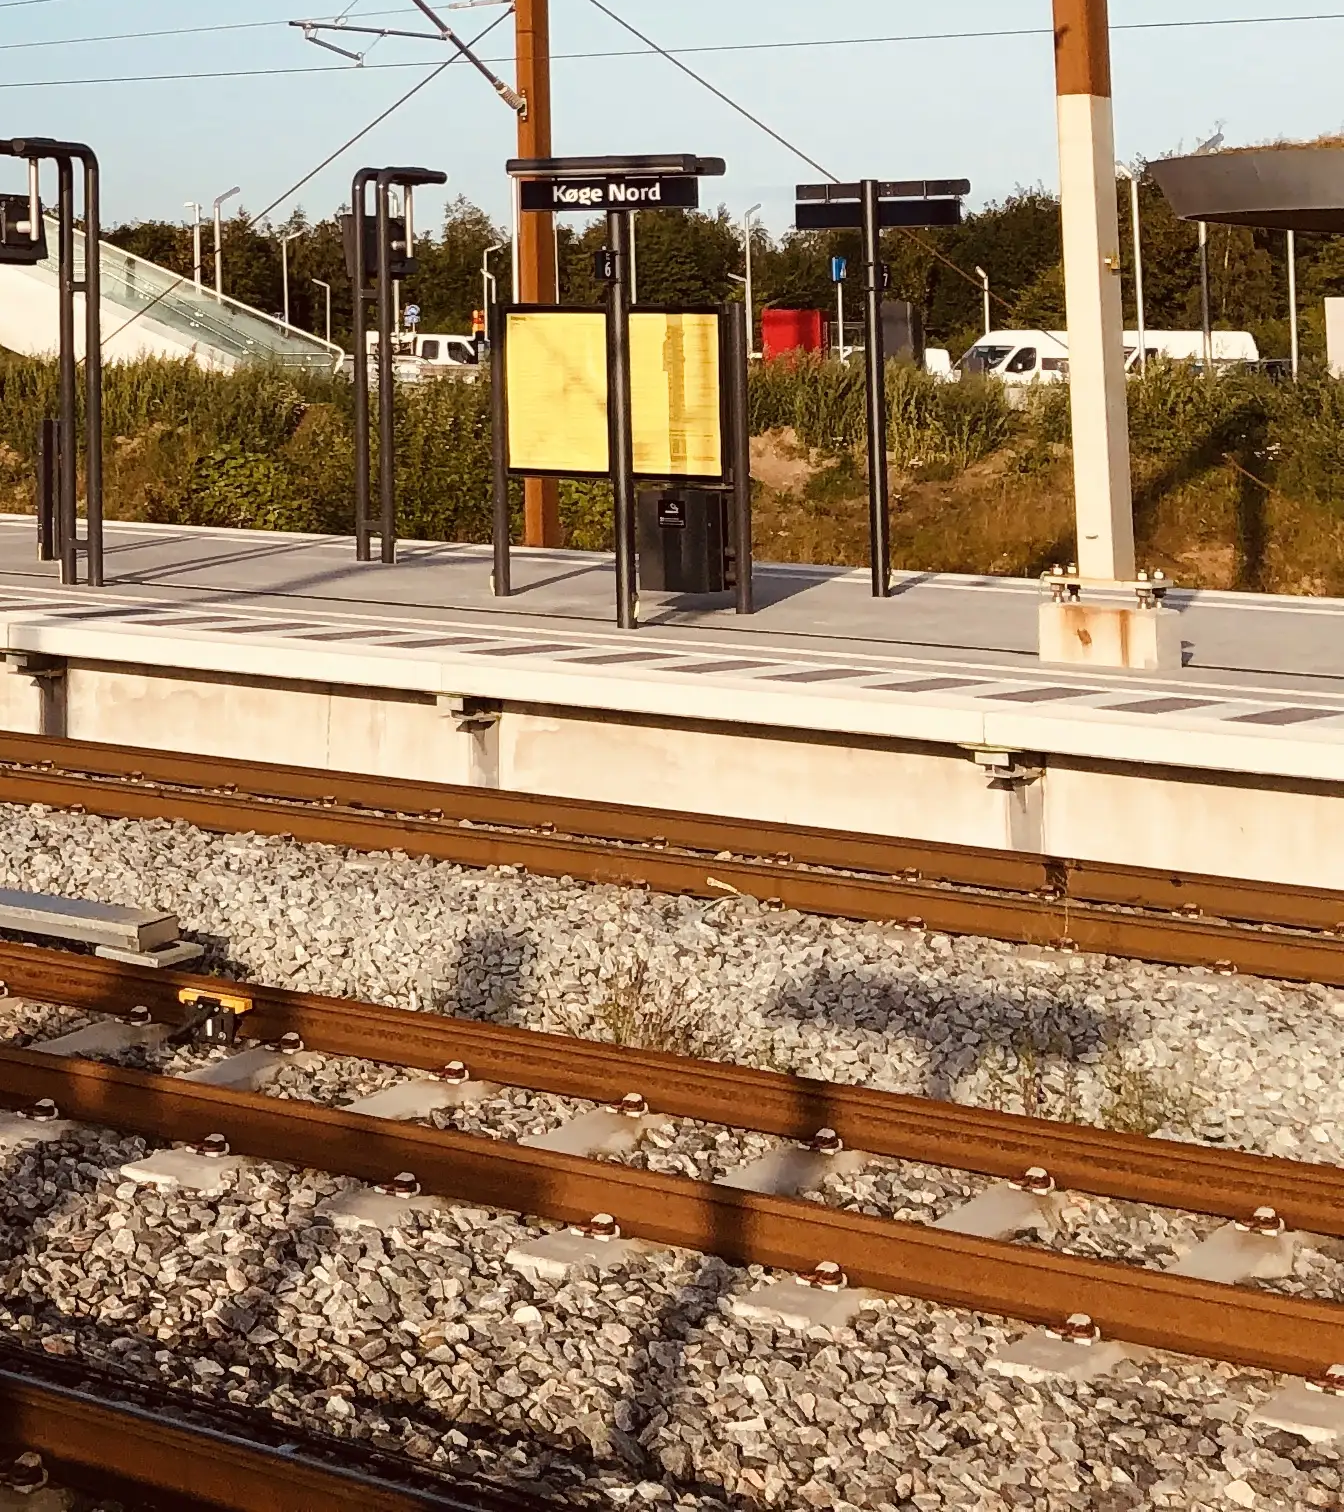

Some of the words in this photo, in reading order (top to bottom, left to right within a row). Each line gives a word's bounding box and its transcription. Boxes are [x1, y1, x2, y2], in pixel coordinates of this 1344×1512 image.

[553, 185, 602, 205] Køge
[608, 182, 661, 202] Nord
[604, 261, 612, 278] 6
[882, 272, 889, 287] 7
